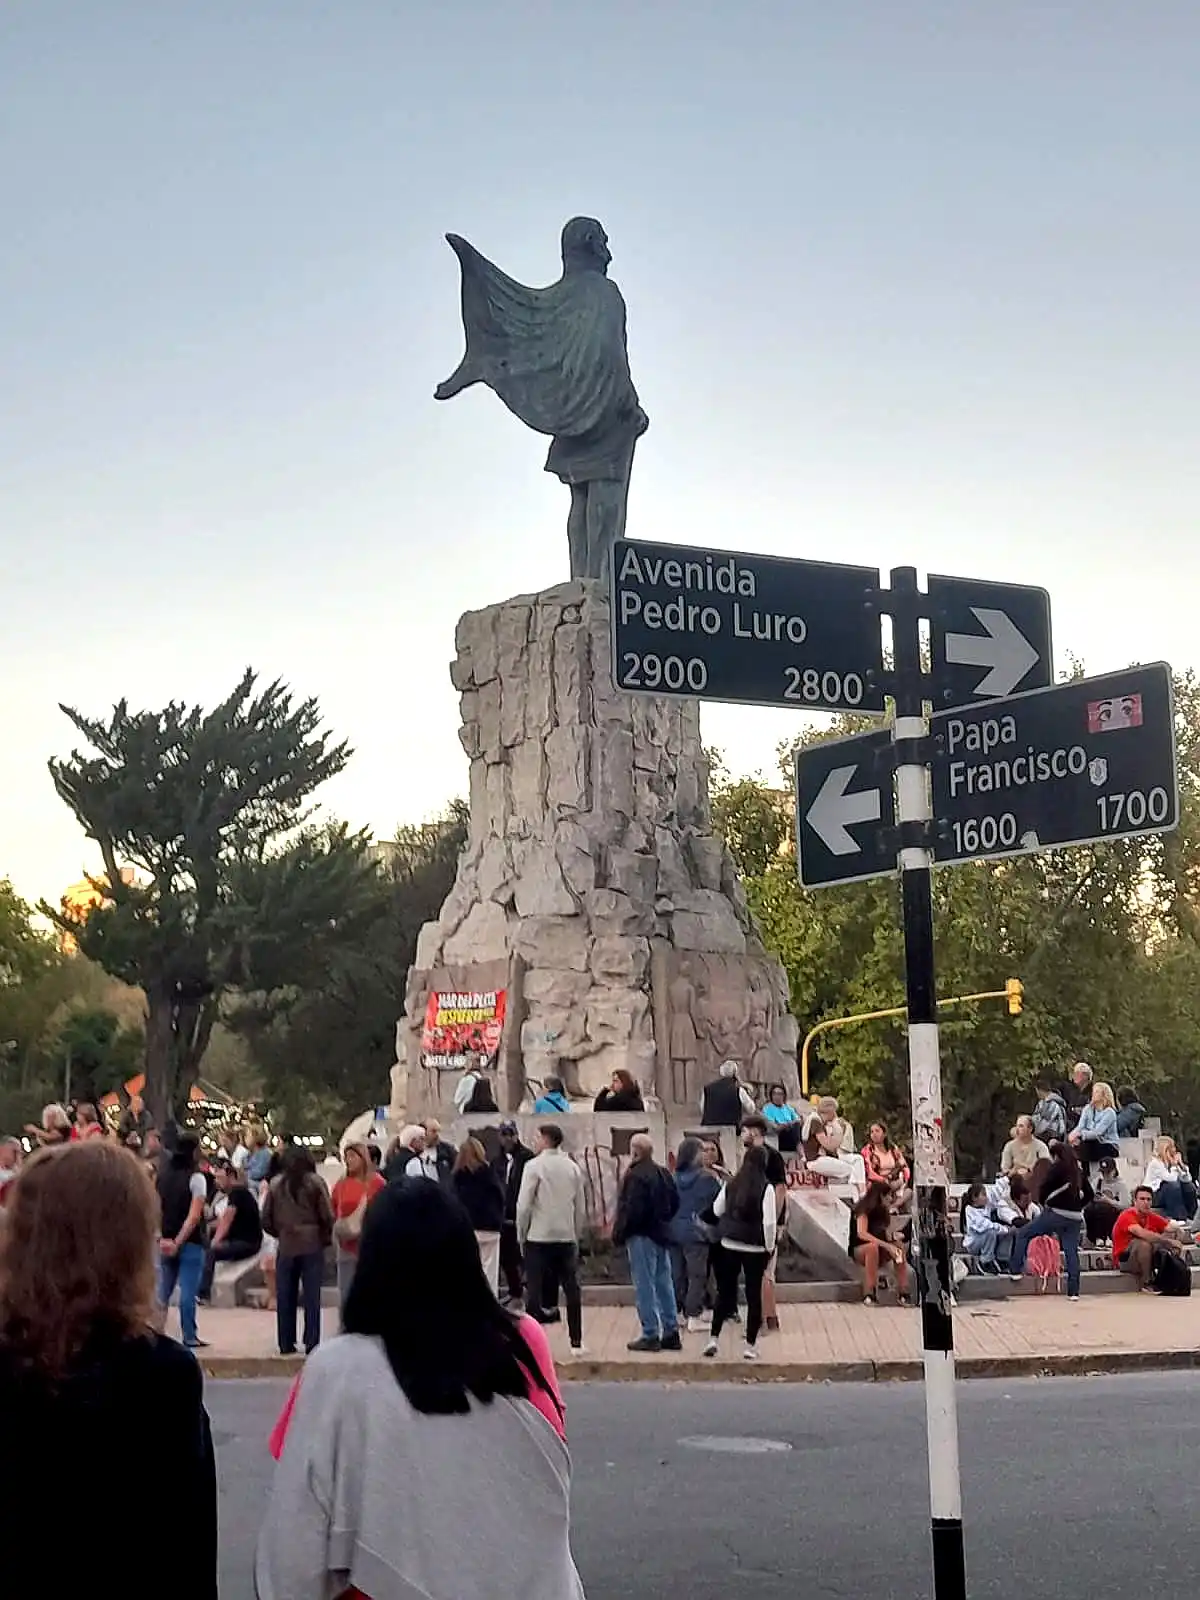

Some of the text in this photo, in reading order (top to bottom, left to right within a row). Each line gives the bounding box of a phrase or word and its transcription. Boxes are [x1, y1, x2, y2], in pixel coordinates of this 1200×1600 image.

[619, 547, 756, 597] Avenida
[621, 590, 807, 644] Pedro Luro
[623, 652, 863, 704] 2900 2800
[947, 716, 1017, 755] Papa
[949, 746, 1087, 797] Francisco
[952, 786, 1168, 853] 1600 1700
